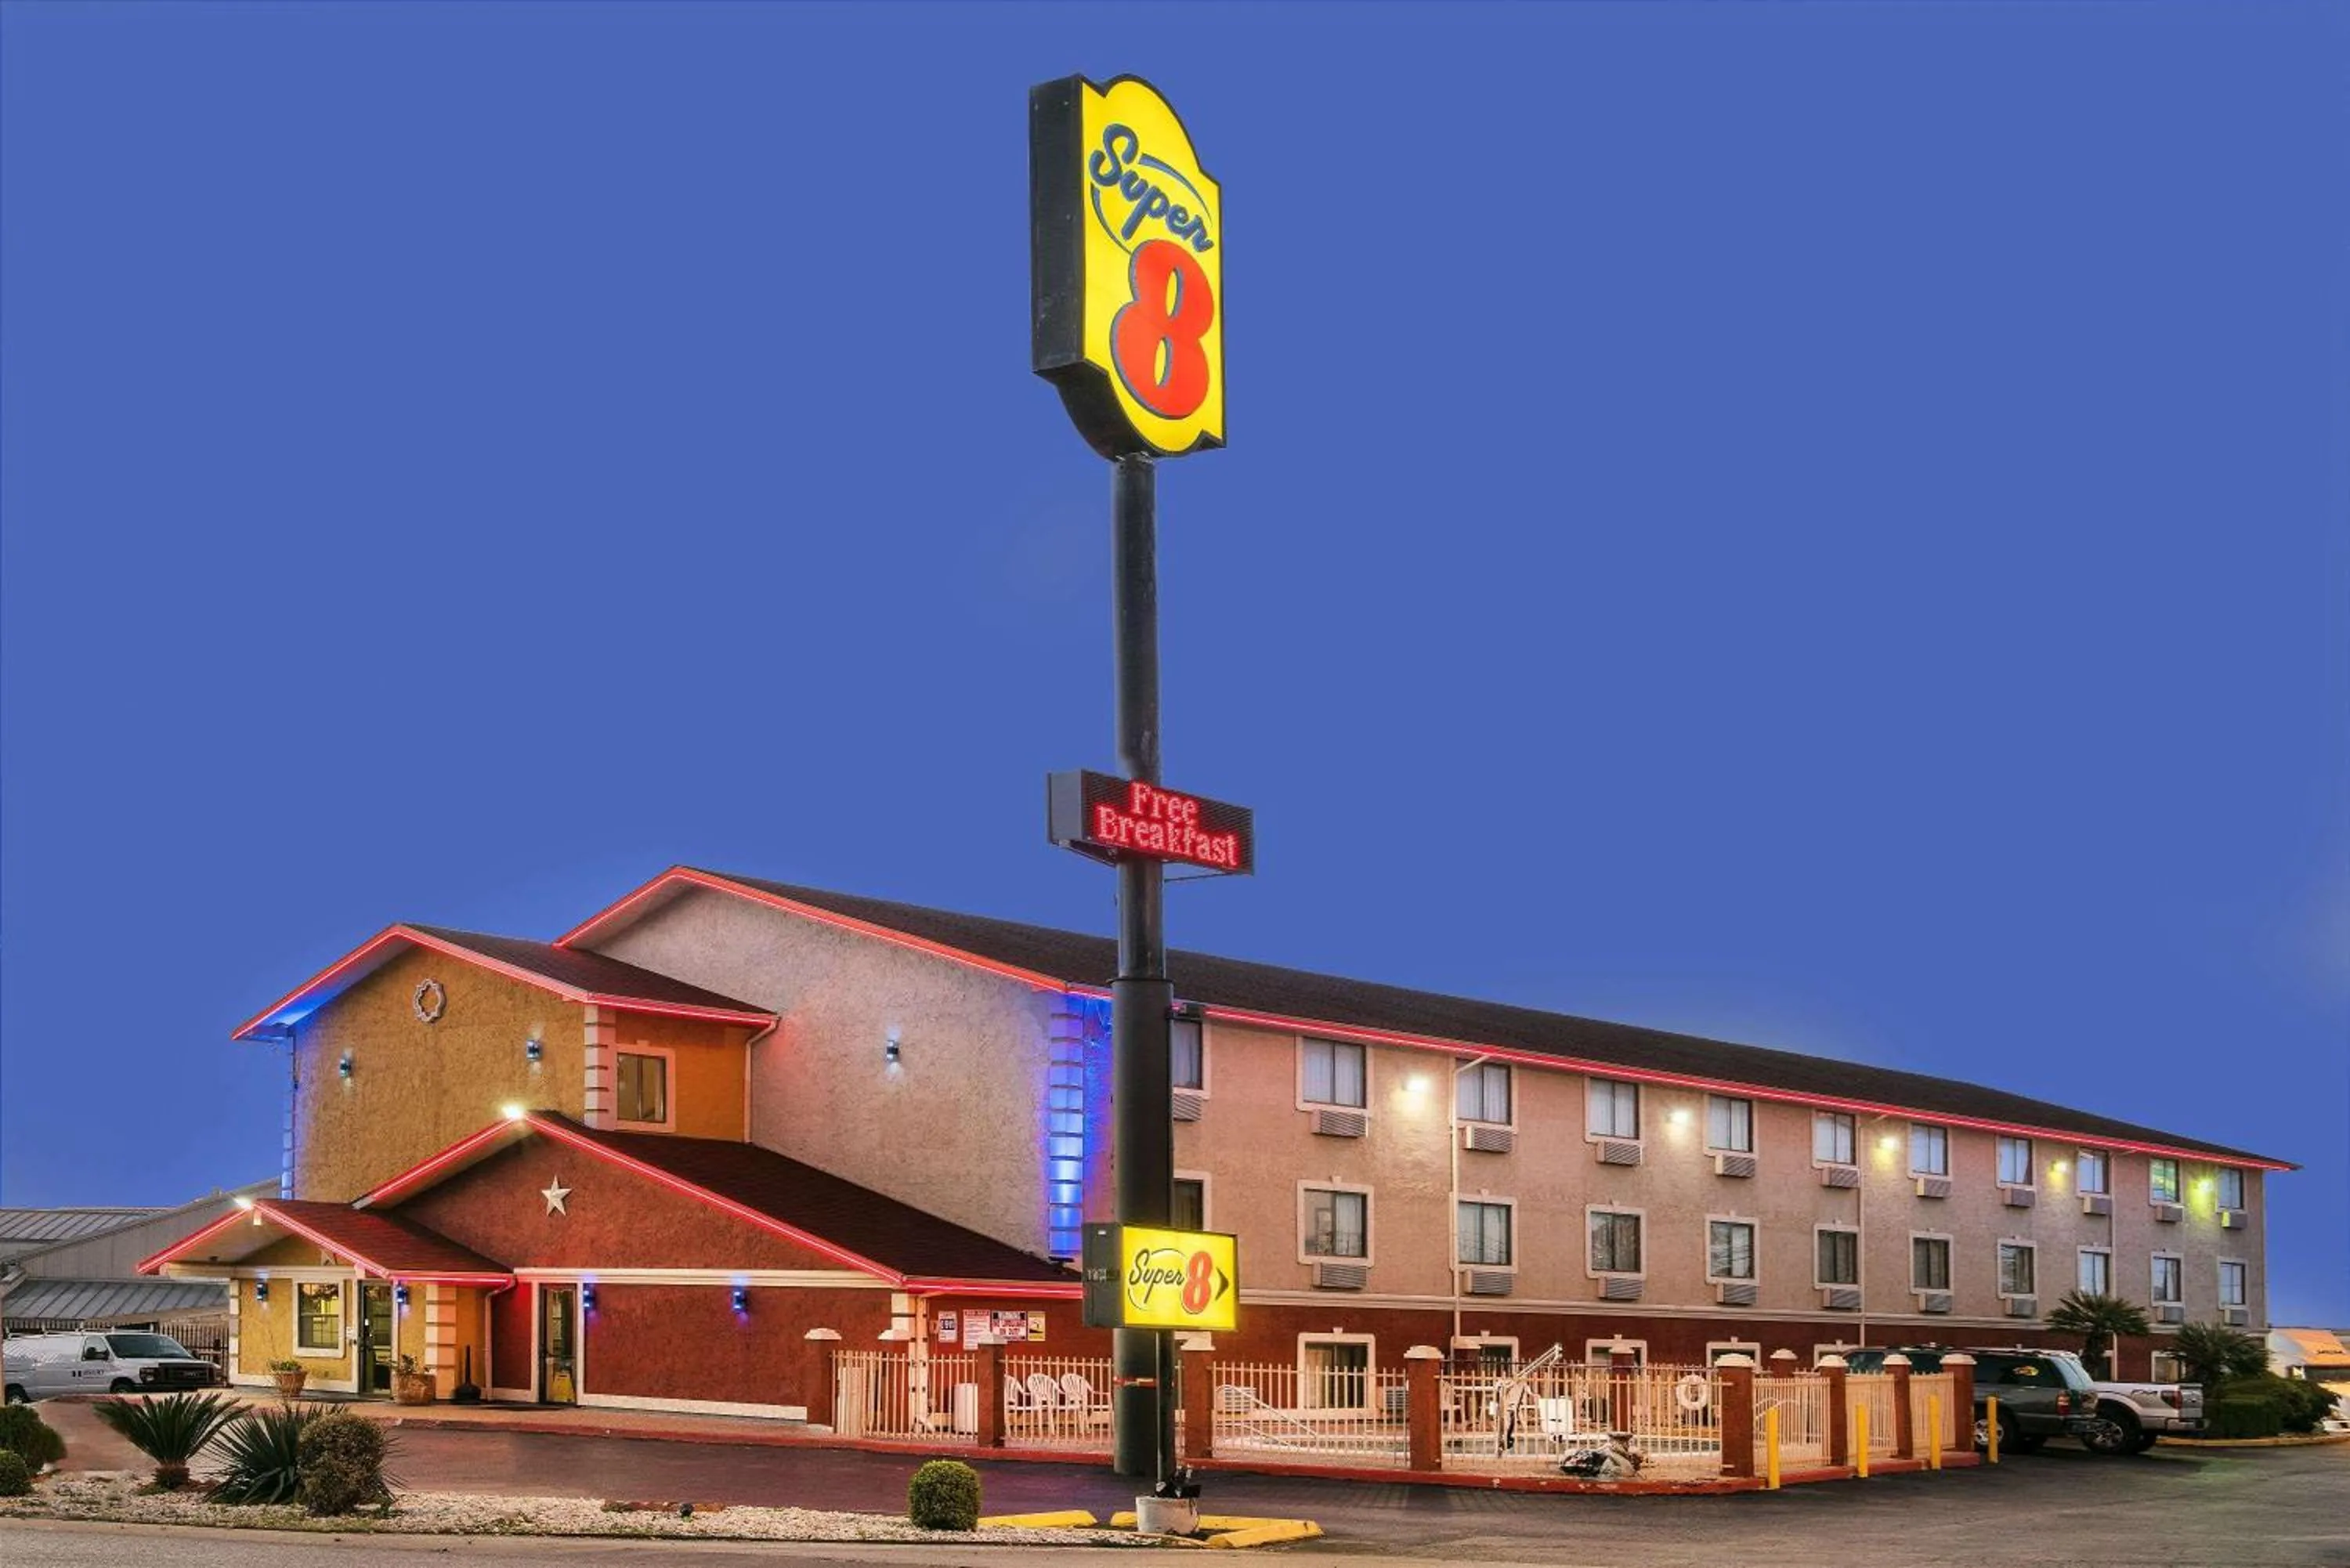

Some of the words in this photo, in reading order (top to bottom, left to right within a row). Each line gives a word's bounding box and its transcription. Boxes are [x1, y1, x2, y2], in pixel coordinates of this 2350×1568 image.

[1089, 123, 1214, 253] Super
[1109, 238, 1214, 420] 8
[1097, 805, 1237, 866] Breakfast
[1131, 782, 1198, 823] Free
[1129, 1248, 1185, 1304] Super
[1182, 1251, 1213, 1315] 8
